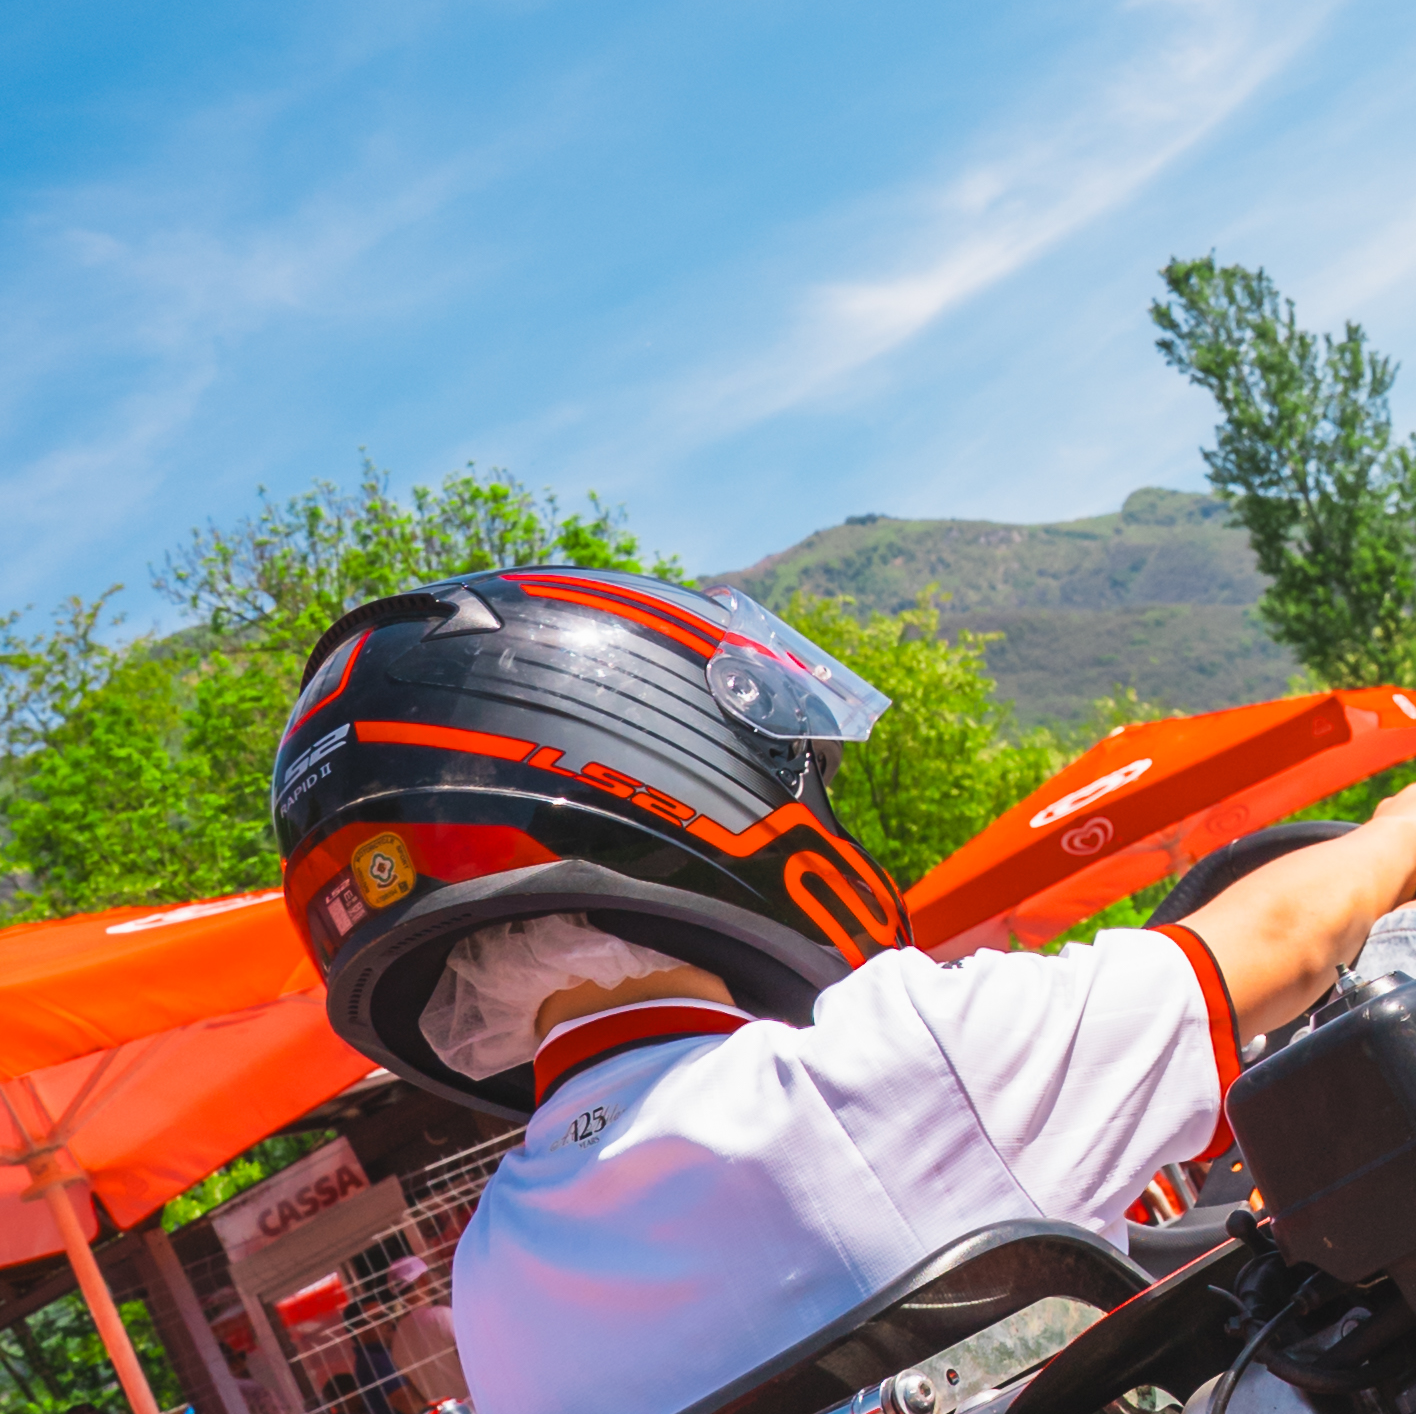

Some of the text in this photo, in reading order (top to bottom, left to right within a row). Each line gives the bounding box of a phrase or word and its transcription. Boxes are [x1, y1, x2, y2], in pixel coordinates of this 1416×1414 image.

[280, 774, 318, 818] RAPID
[527, 746, 698, 829] LS2
[257, 1162, 365, 1238] CASSA
